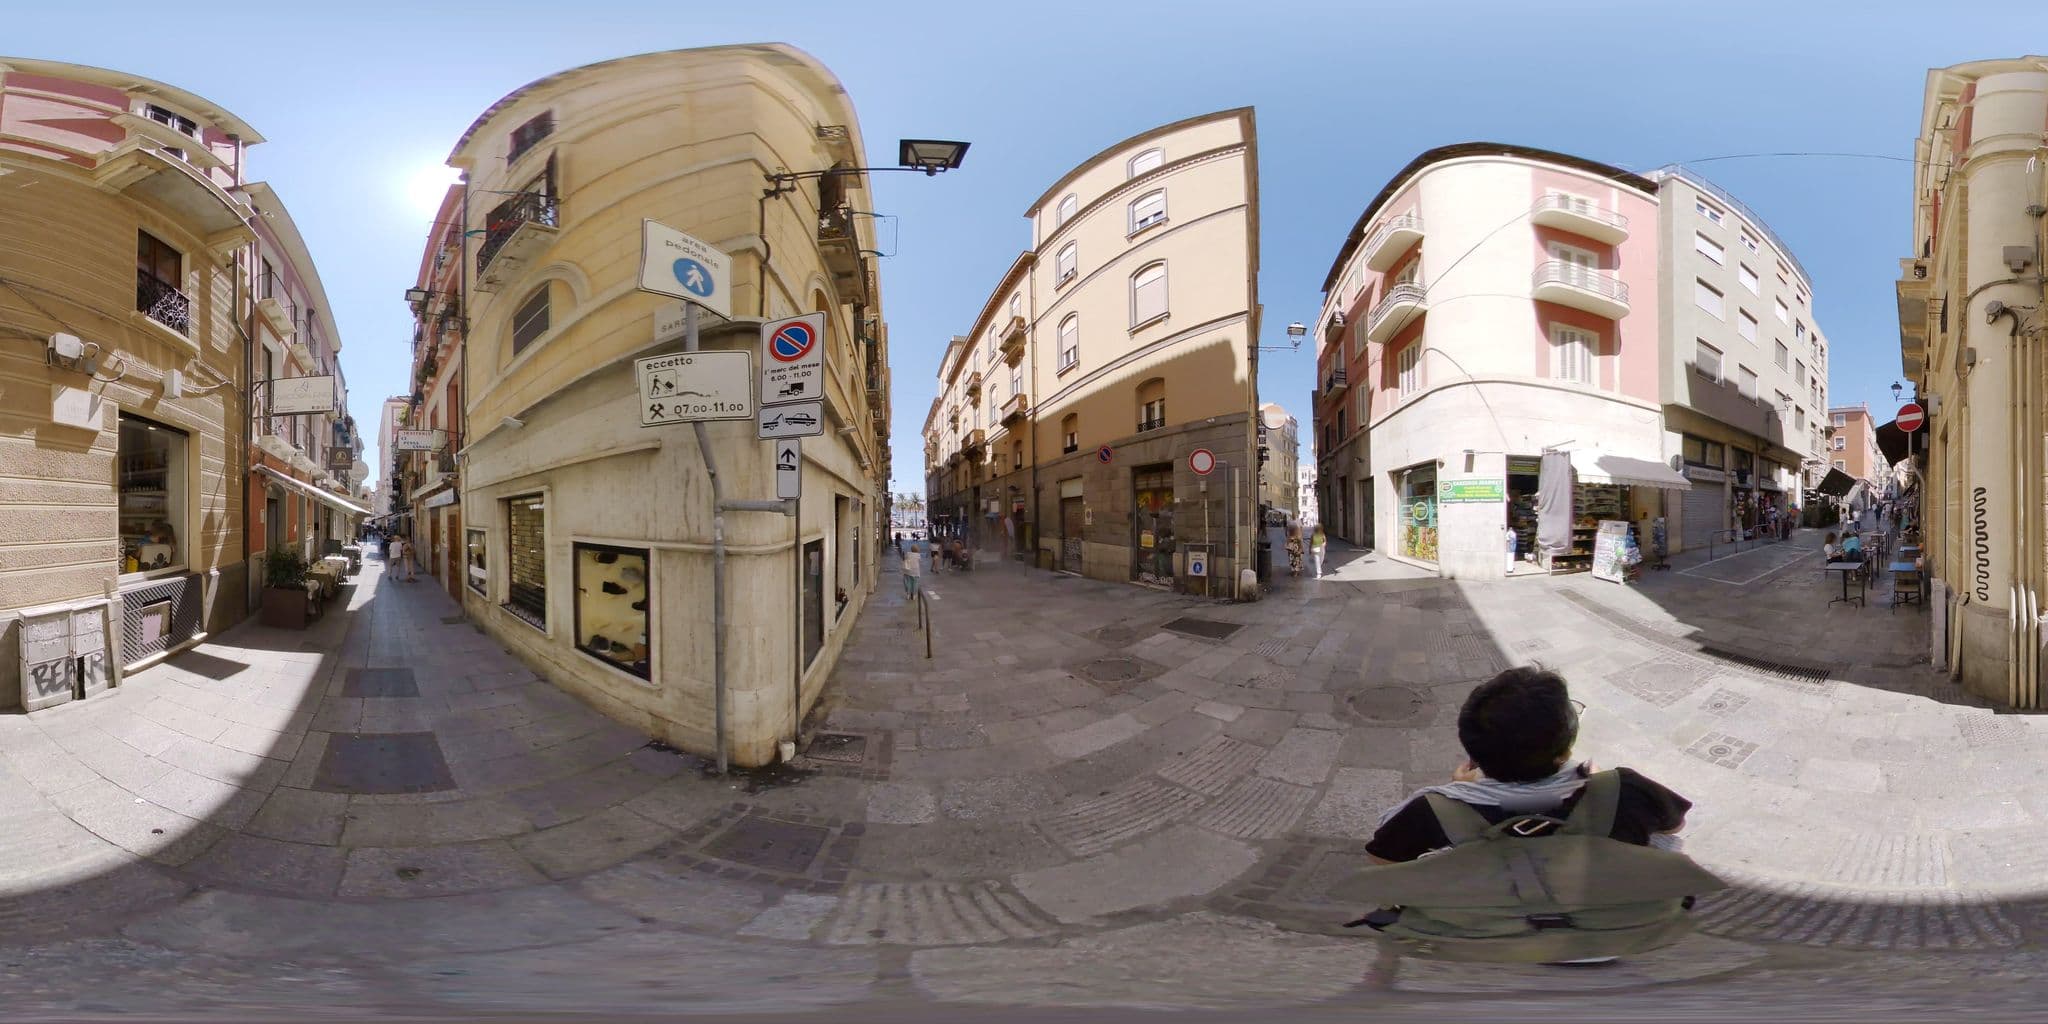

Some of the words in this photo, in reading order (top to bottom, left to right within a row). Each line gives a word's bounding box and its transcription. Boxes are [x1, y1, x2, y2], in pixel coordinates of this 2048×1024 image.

[681, 237, 707, 253] area
[665, 239, 719, 270] pedonale
[646, 357, 693, 370] eccetto
